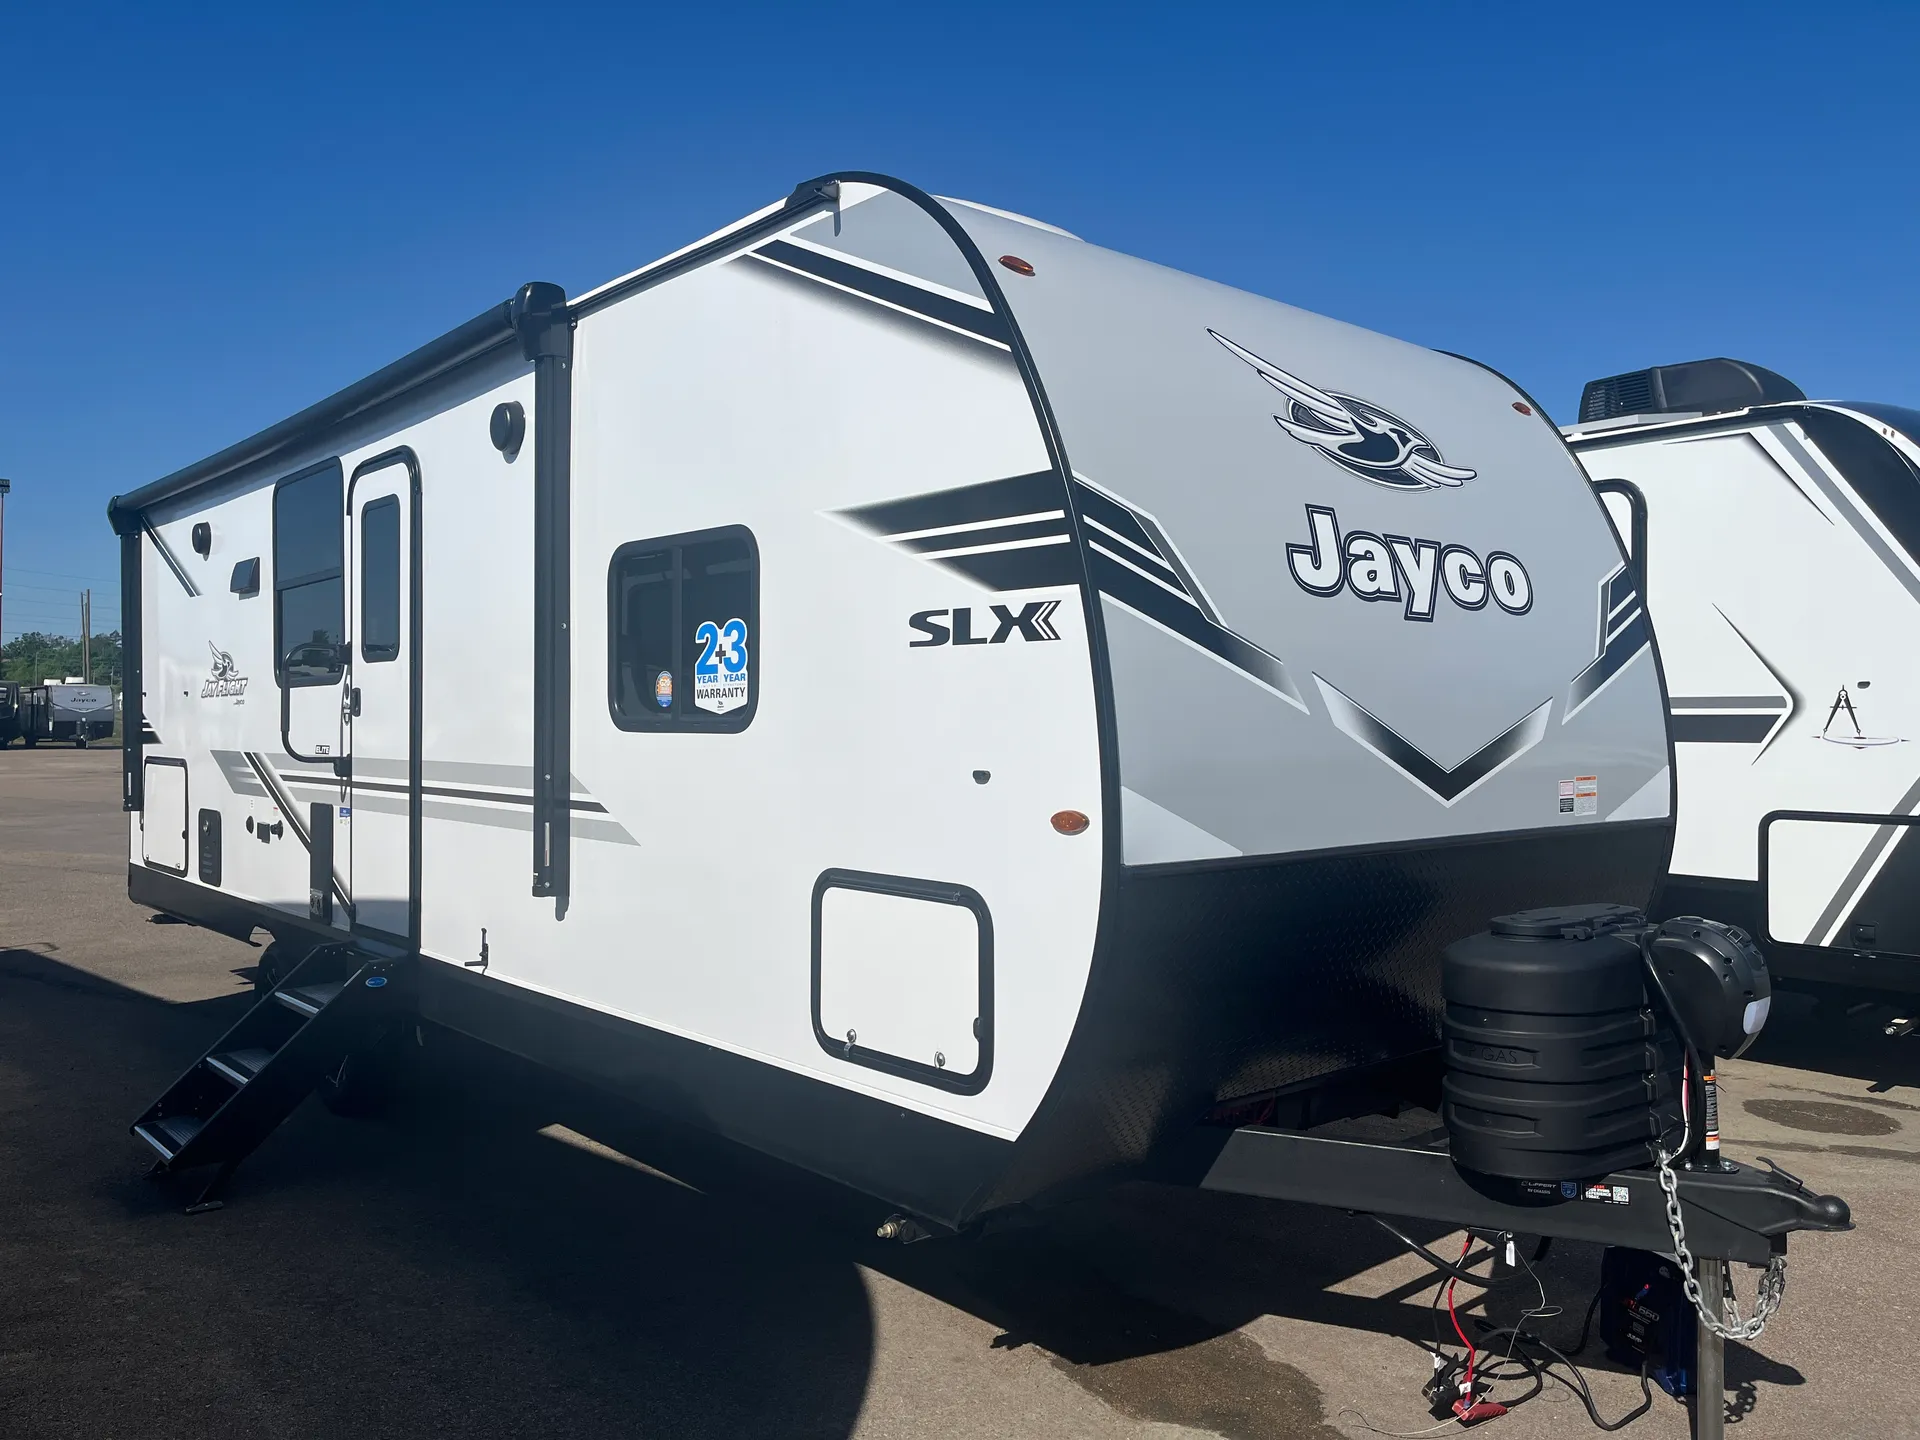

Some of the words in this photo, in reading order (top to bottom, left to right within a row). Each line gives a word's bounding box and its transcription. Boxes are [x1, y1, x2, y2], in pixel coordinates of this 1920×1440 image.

[1285, 503, 1533, 622] Jayco
[909, 600, 1062, 647] SLX
[697, 675, 719, 684] YEAR
[723, 673, 746, 682] YEAR
[696, 687, 746, 699] WARRANTY
[1481, 1046, 1518, 1064] GAS
